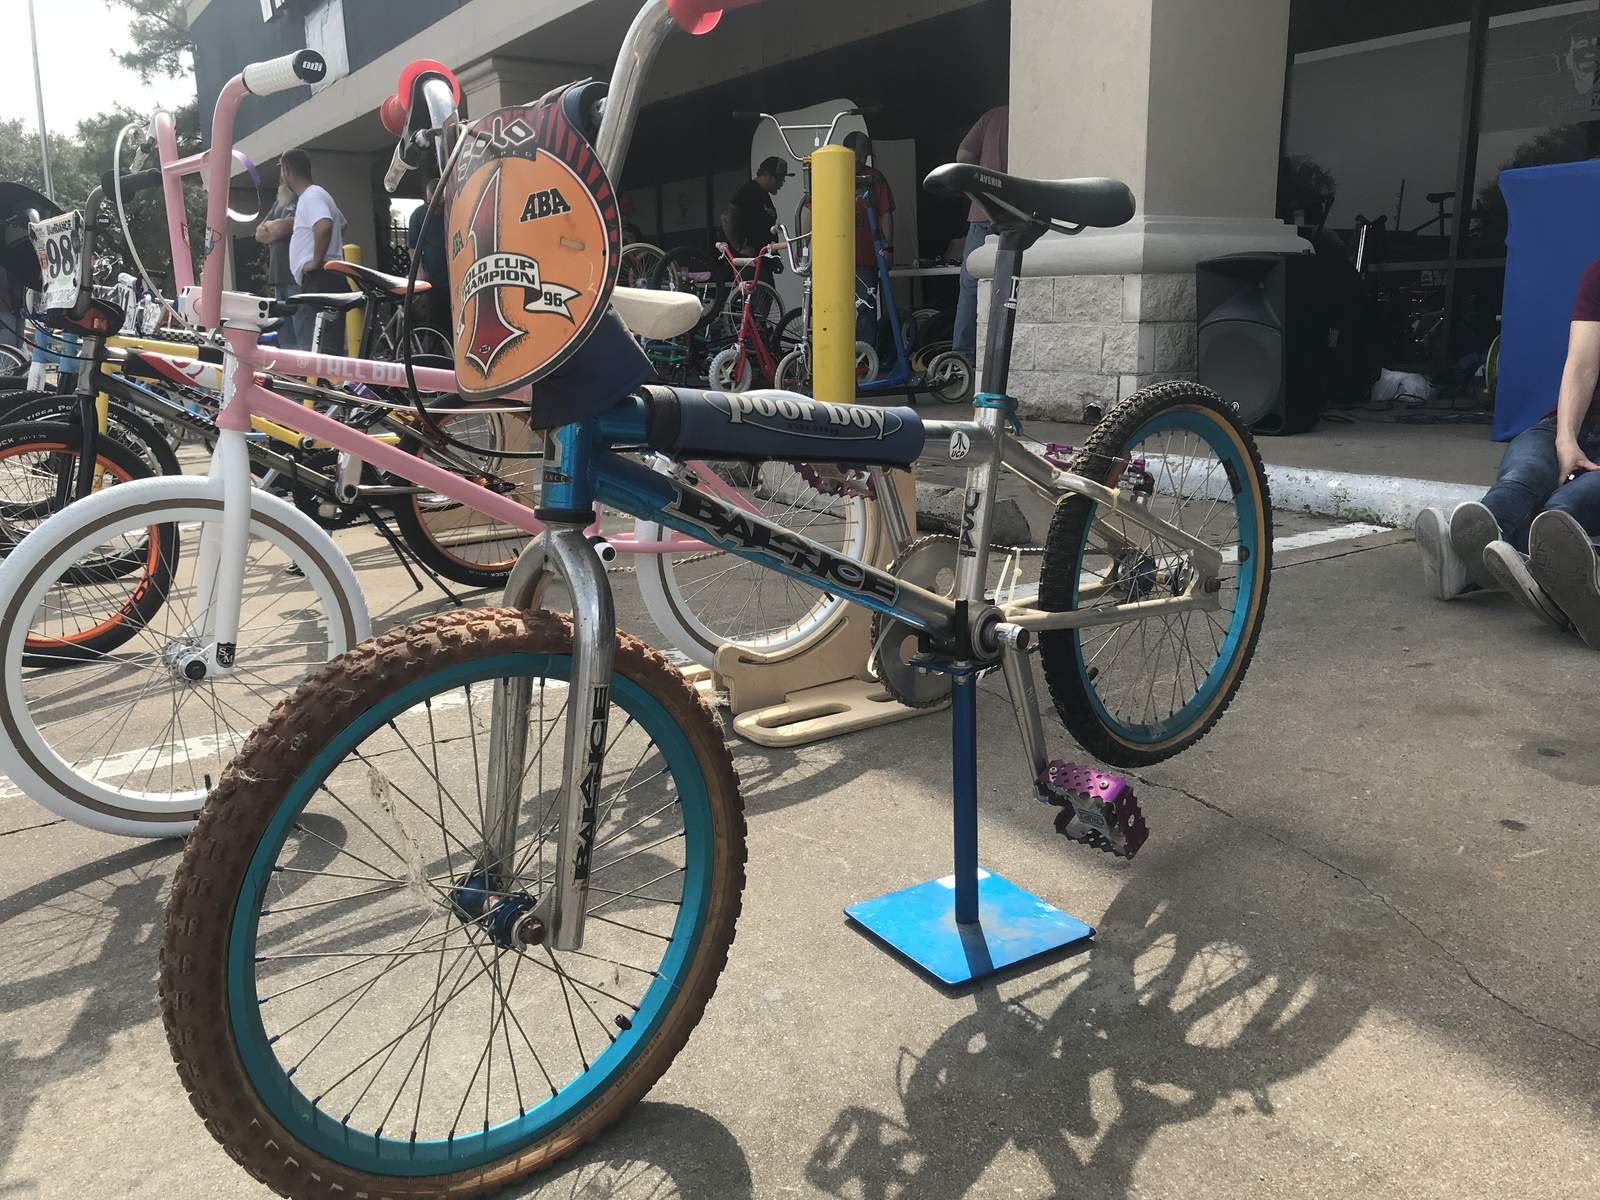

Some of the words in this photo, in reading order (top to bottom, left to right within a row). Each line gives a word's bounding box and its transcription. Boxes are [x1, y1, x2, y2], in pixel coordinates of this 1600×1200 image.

[979, 174, 1002, 188] AVENIR
[519, 187, 571, 224] ABA
[46, 235, 74, 279] 98
[464, 260, 488, 286] OLD
[494, 257, 535, 271] CUP
[463, 269, 536, 297] HAMPION
[543, 291, 563, 307] 96
[372, 360, 407, 384] BO
[724, 393, 815, 424] poor
[818, 401, 886, 441] boy
[961, 490, 979, 549] USA
